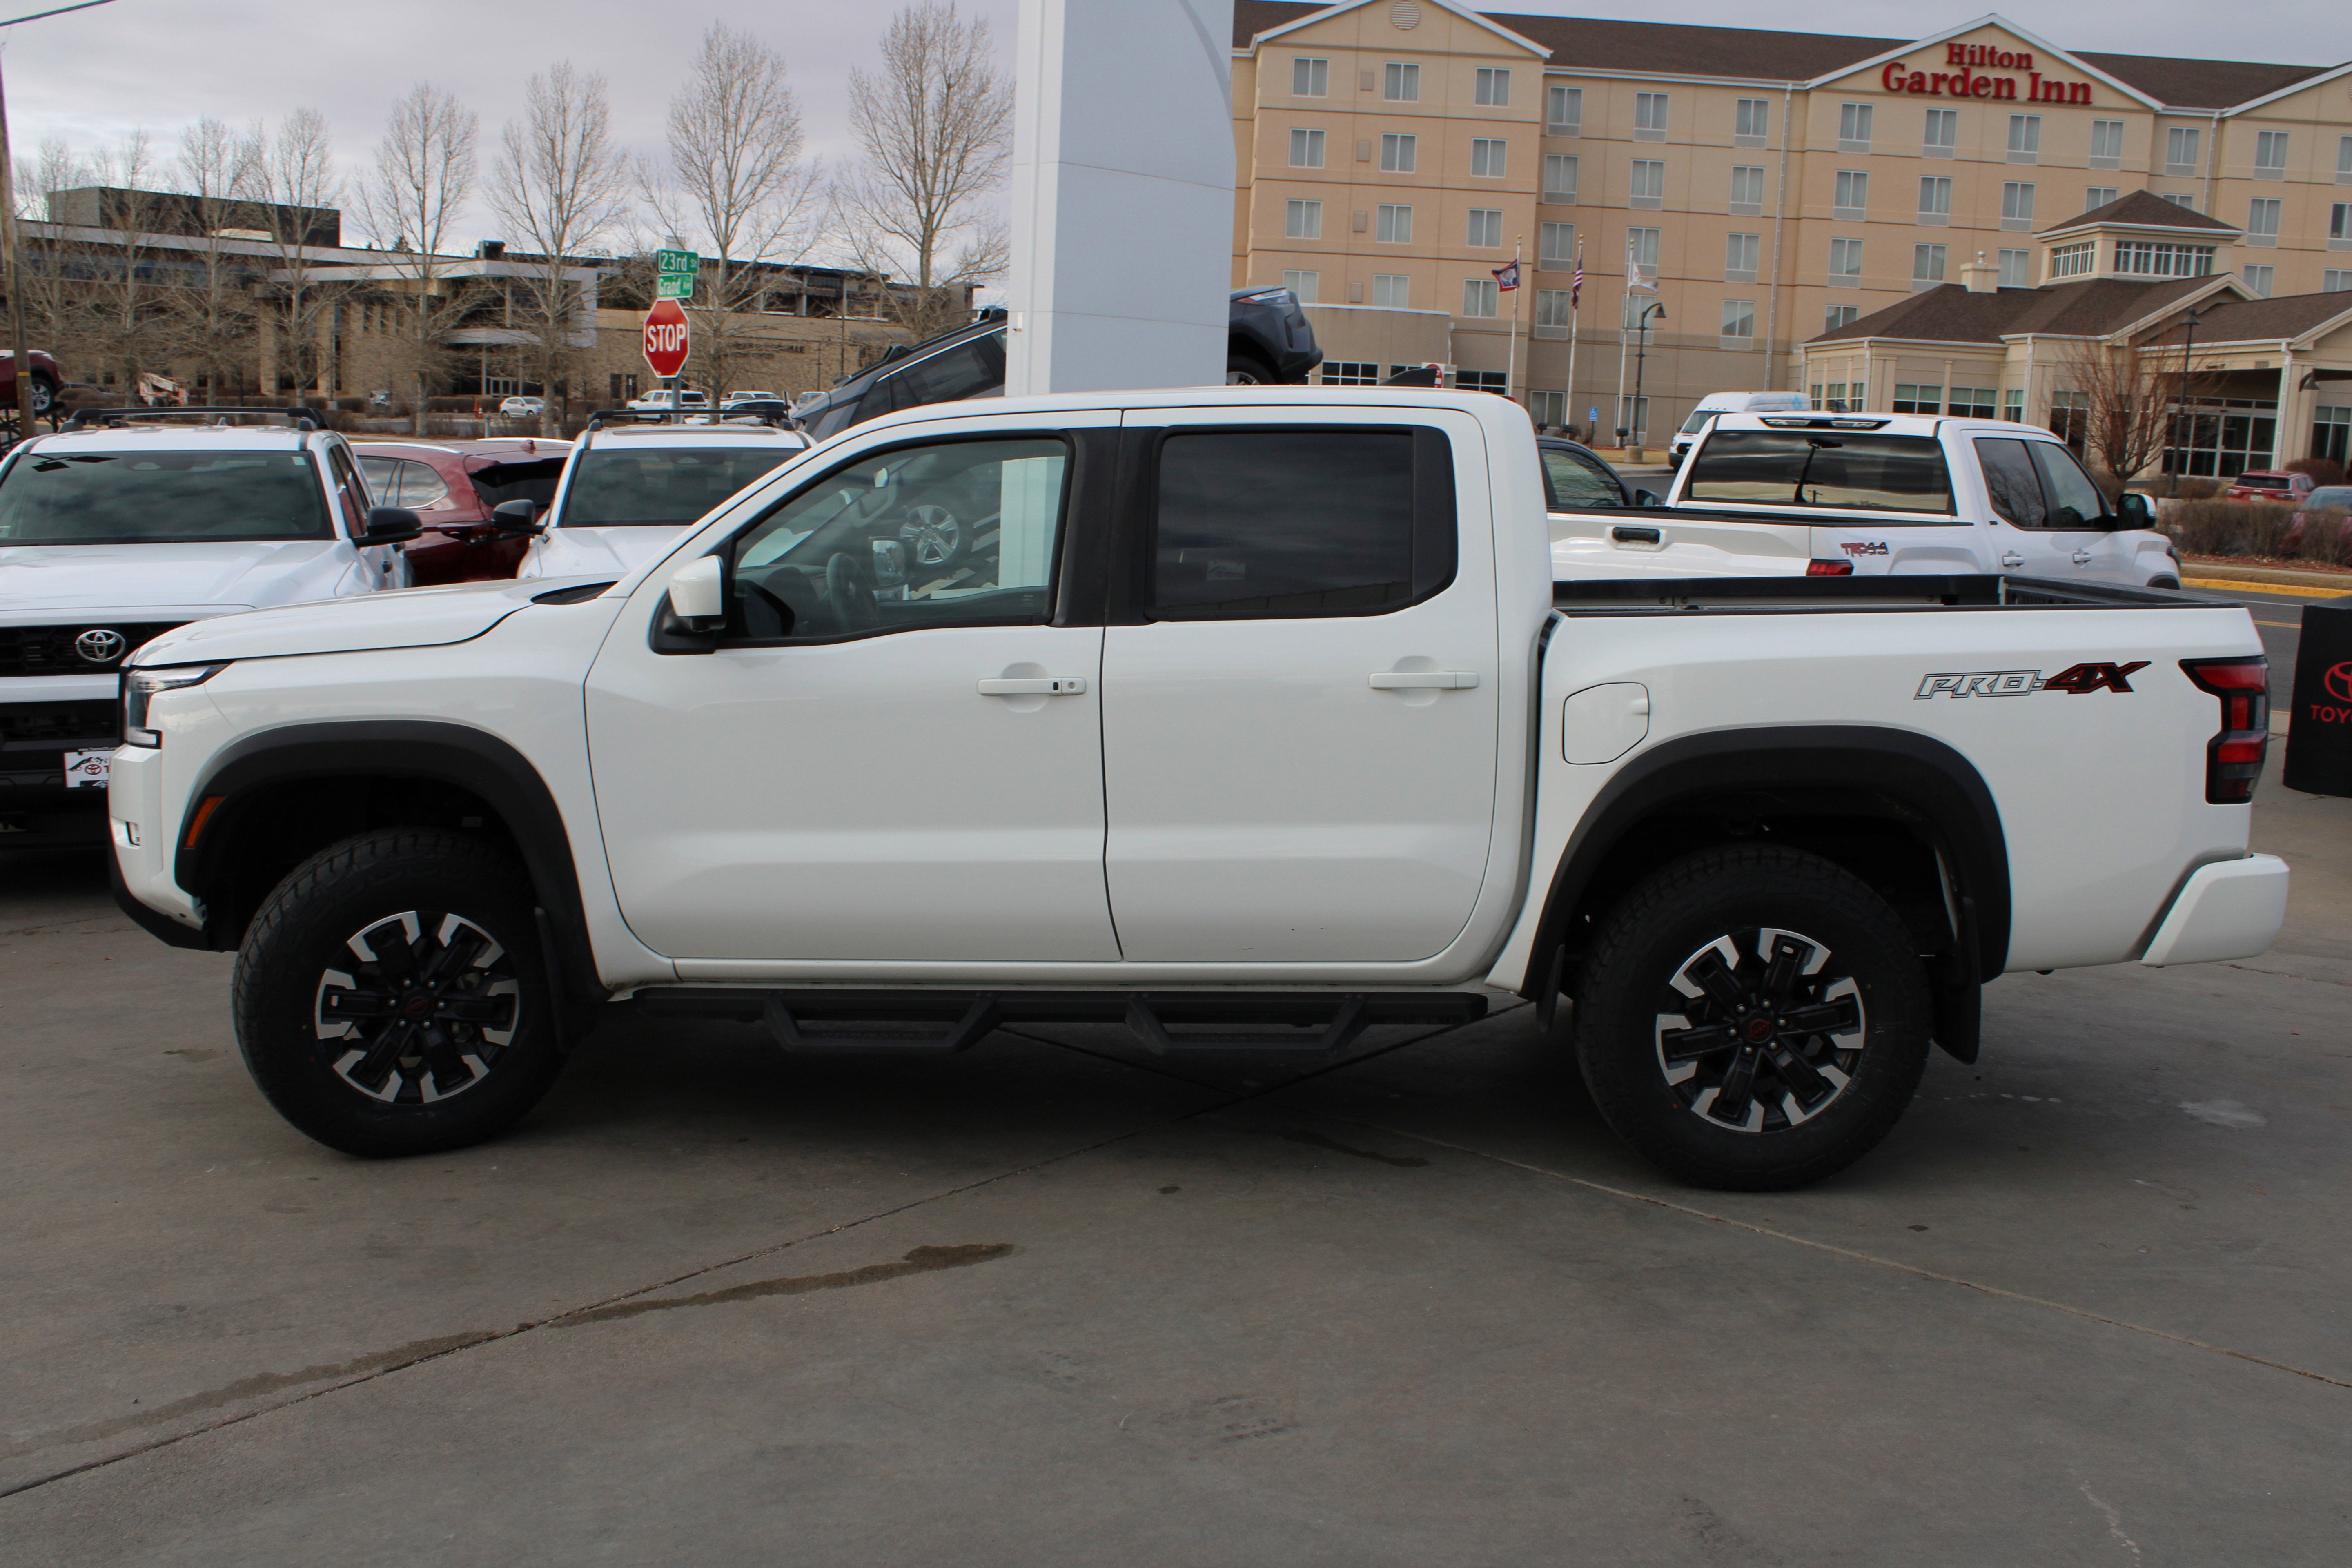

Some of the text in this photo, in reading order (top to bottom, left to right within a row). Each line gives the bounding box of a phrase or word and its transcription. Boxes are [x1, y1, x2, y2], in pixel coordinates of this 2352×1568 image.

[1946, 42, 2033, 69] Hilton
[1882, 62, 2092, 104] Garden Inn
[661, 252, 687, 272] 23rd
[659, 277, 681, 295] Grand
[647, 323, 686, 352] STOP
[2310, 704, 2352, 724] TOY
